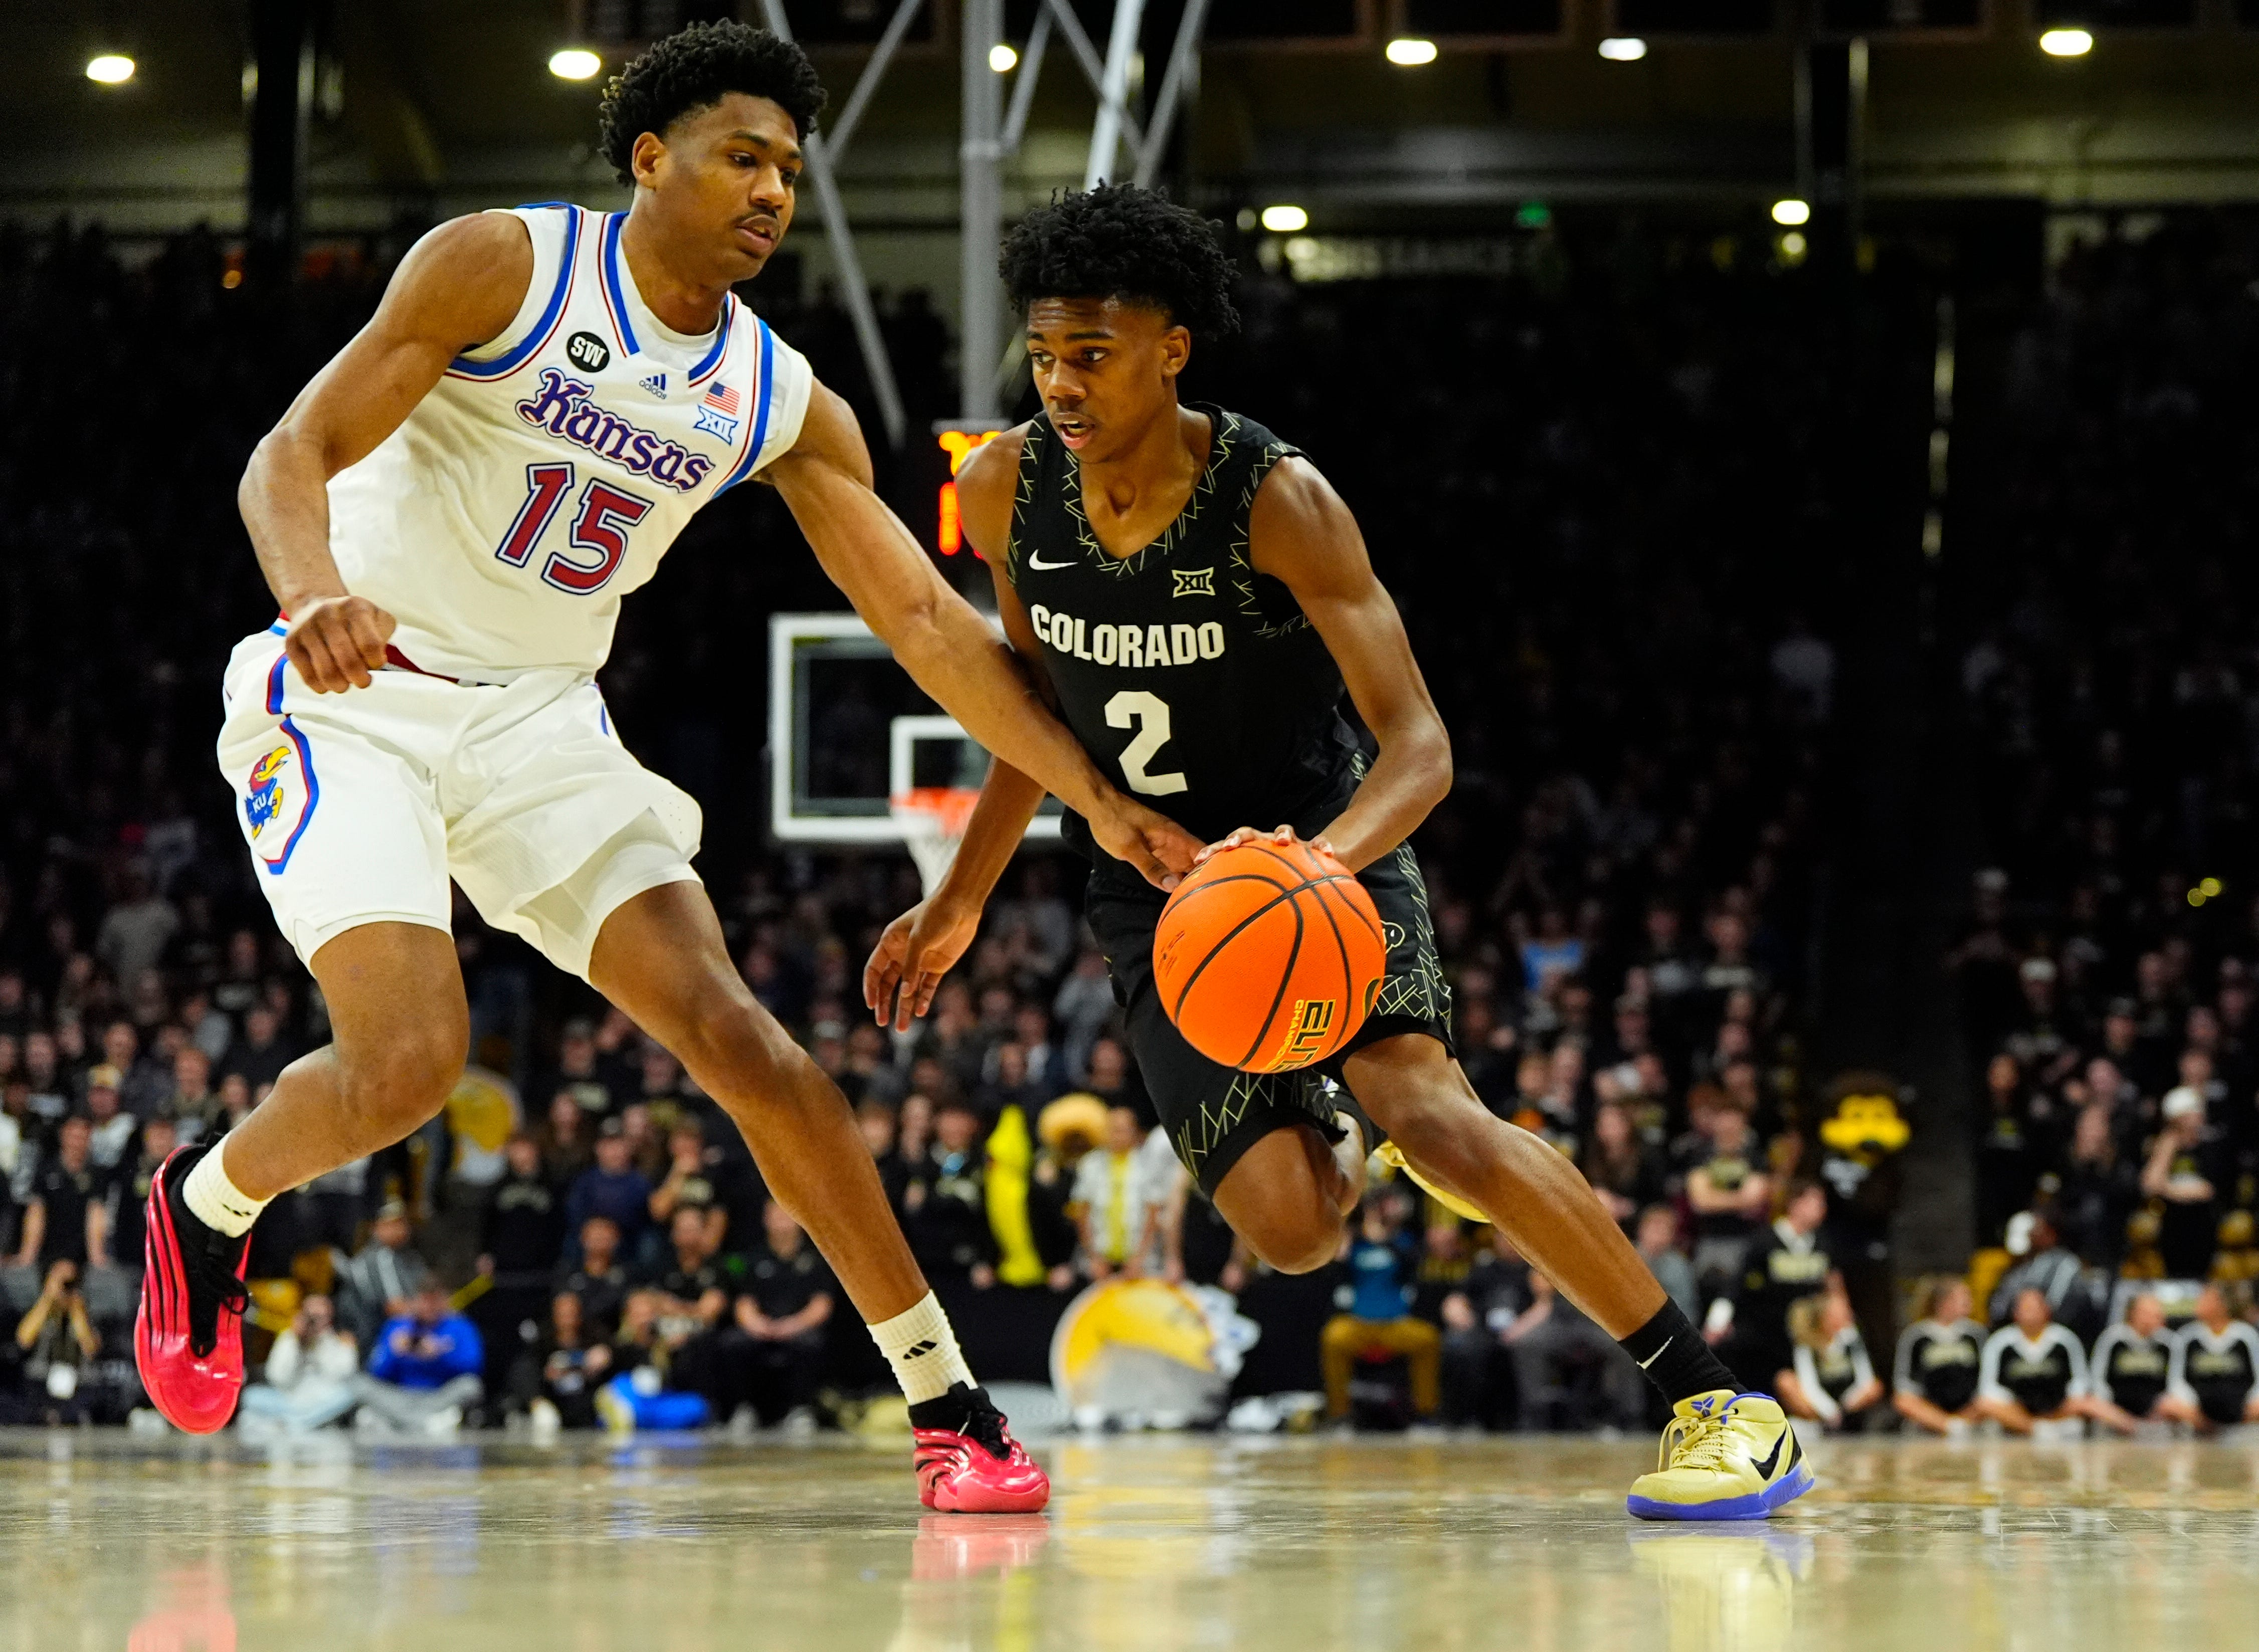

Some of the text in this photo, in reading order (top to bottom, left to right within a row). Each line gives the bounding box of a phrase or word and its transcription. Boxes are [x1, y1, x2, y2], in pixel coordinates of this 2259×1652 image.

[571, 334, 607, 368] SW
[639, 379, 667, 400] adidas
[515, 367, 716, 493] Kansas
[495, 462, 654, 595] 15
[1173, 569, 1214, 596] XII
[1030, 603, 1225, 668] COLORADO
[1104, 691, 1188, 796] 2
[252, 792, 267, 813] KU
